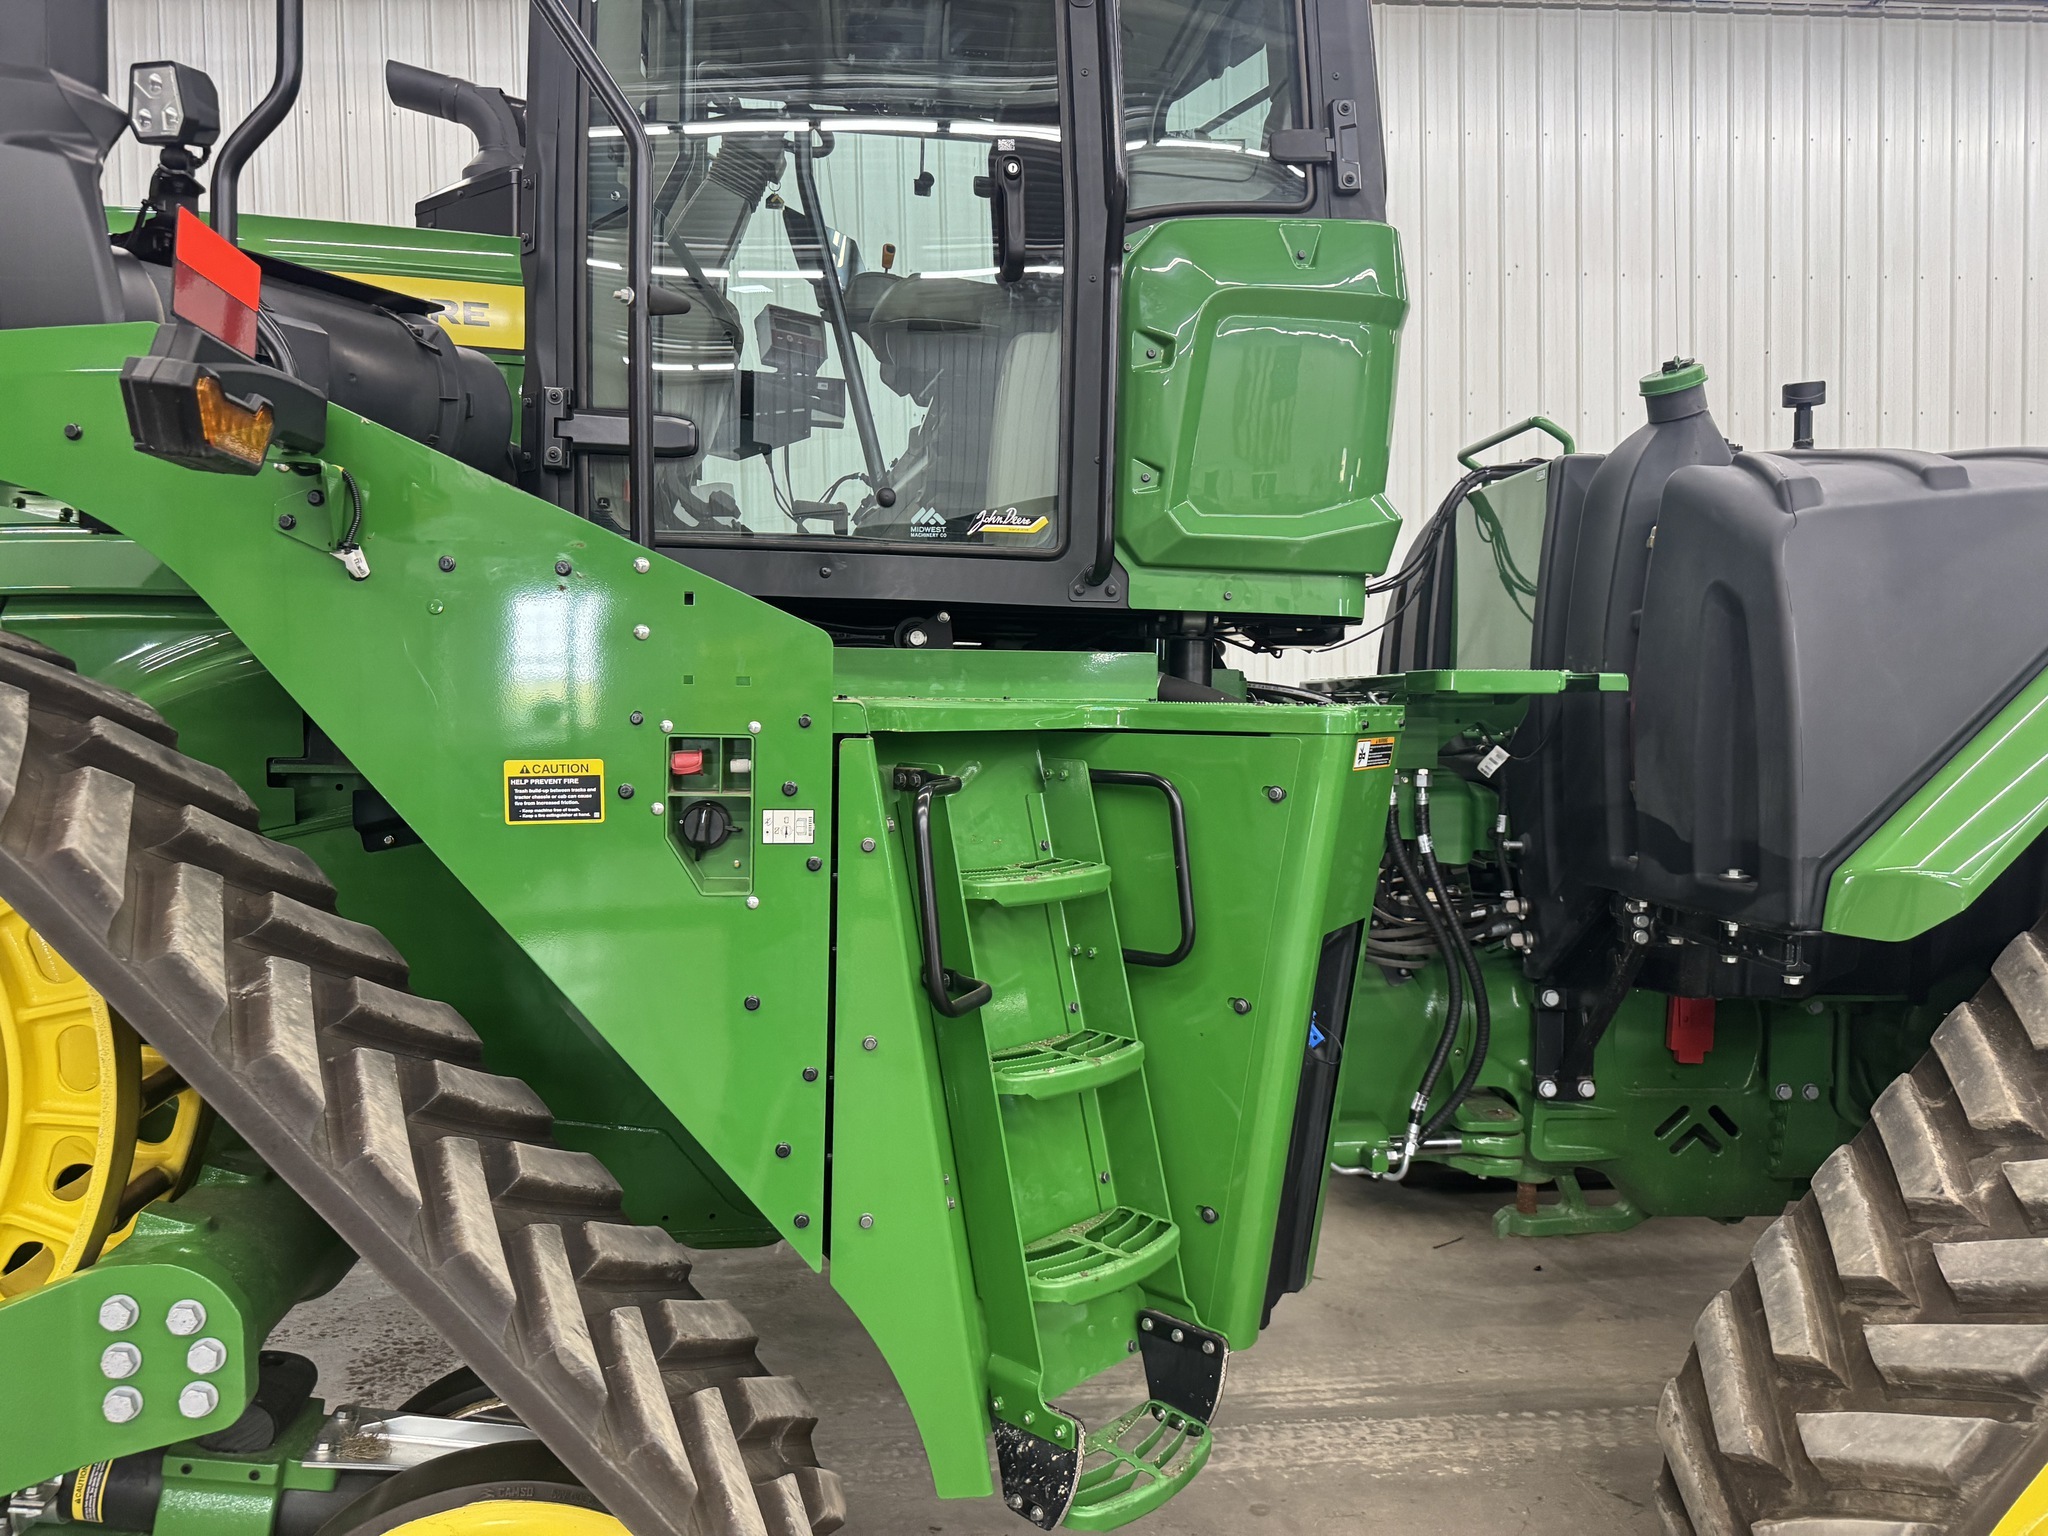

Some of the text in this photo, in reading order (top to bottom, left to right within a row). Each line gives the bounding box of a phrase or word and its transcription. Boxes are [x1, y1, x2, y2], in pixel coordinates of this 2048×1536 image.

[967, 507, 1032, 535] John Deere
[532, 763, 589, 774] CAUTION
[498, 1487, 534, 1497] CAMSO
